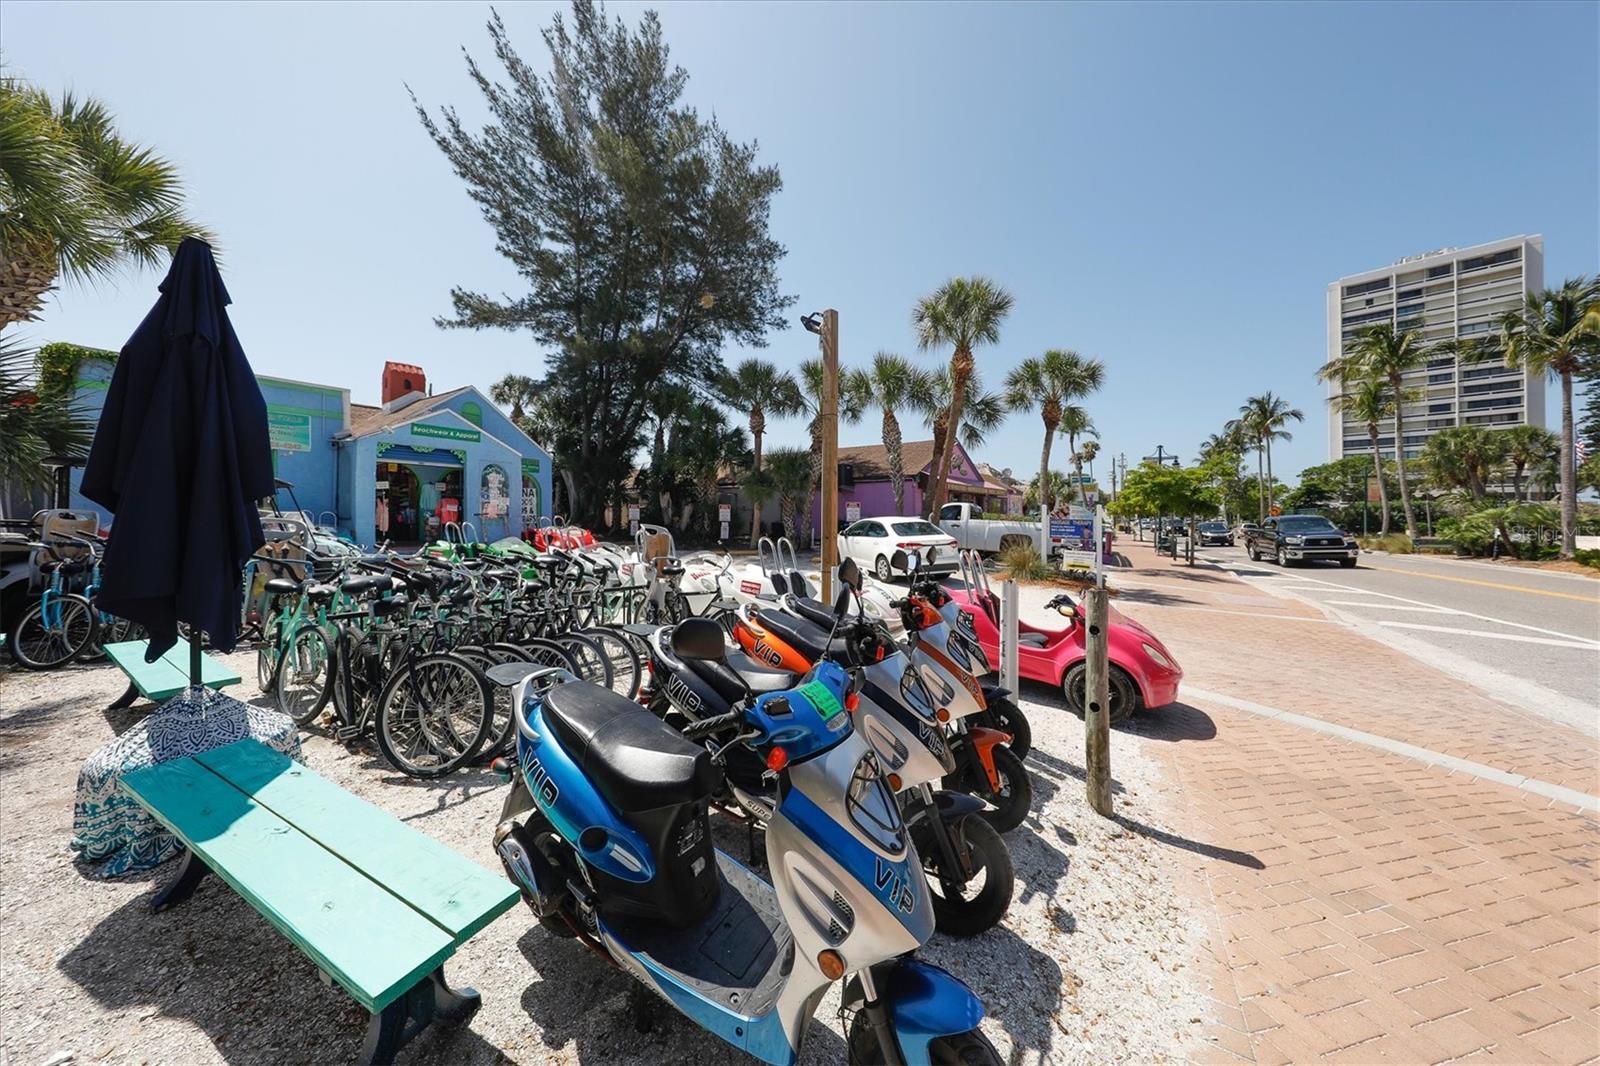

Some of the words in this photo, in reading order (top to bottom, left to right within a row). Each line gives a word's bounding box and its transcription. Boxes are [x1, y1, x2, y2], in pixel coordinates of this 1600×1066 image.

[413, 426, 449, 436] Beachwear
[450, 429, 455, 437] &
[455, 431, 479, 440] Apparel
[753, 636, 783, 667] VIP
[667, 672, 702, 712] VIP
[919, 721, 945, 755] VIP
[523, 745, 559, 808] VIP
[874, 856, 916, 915] VIP
